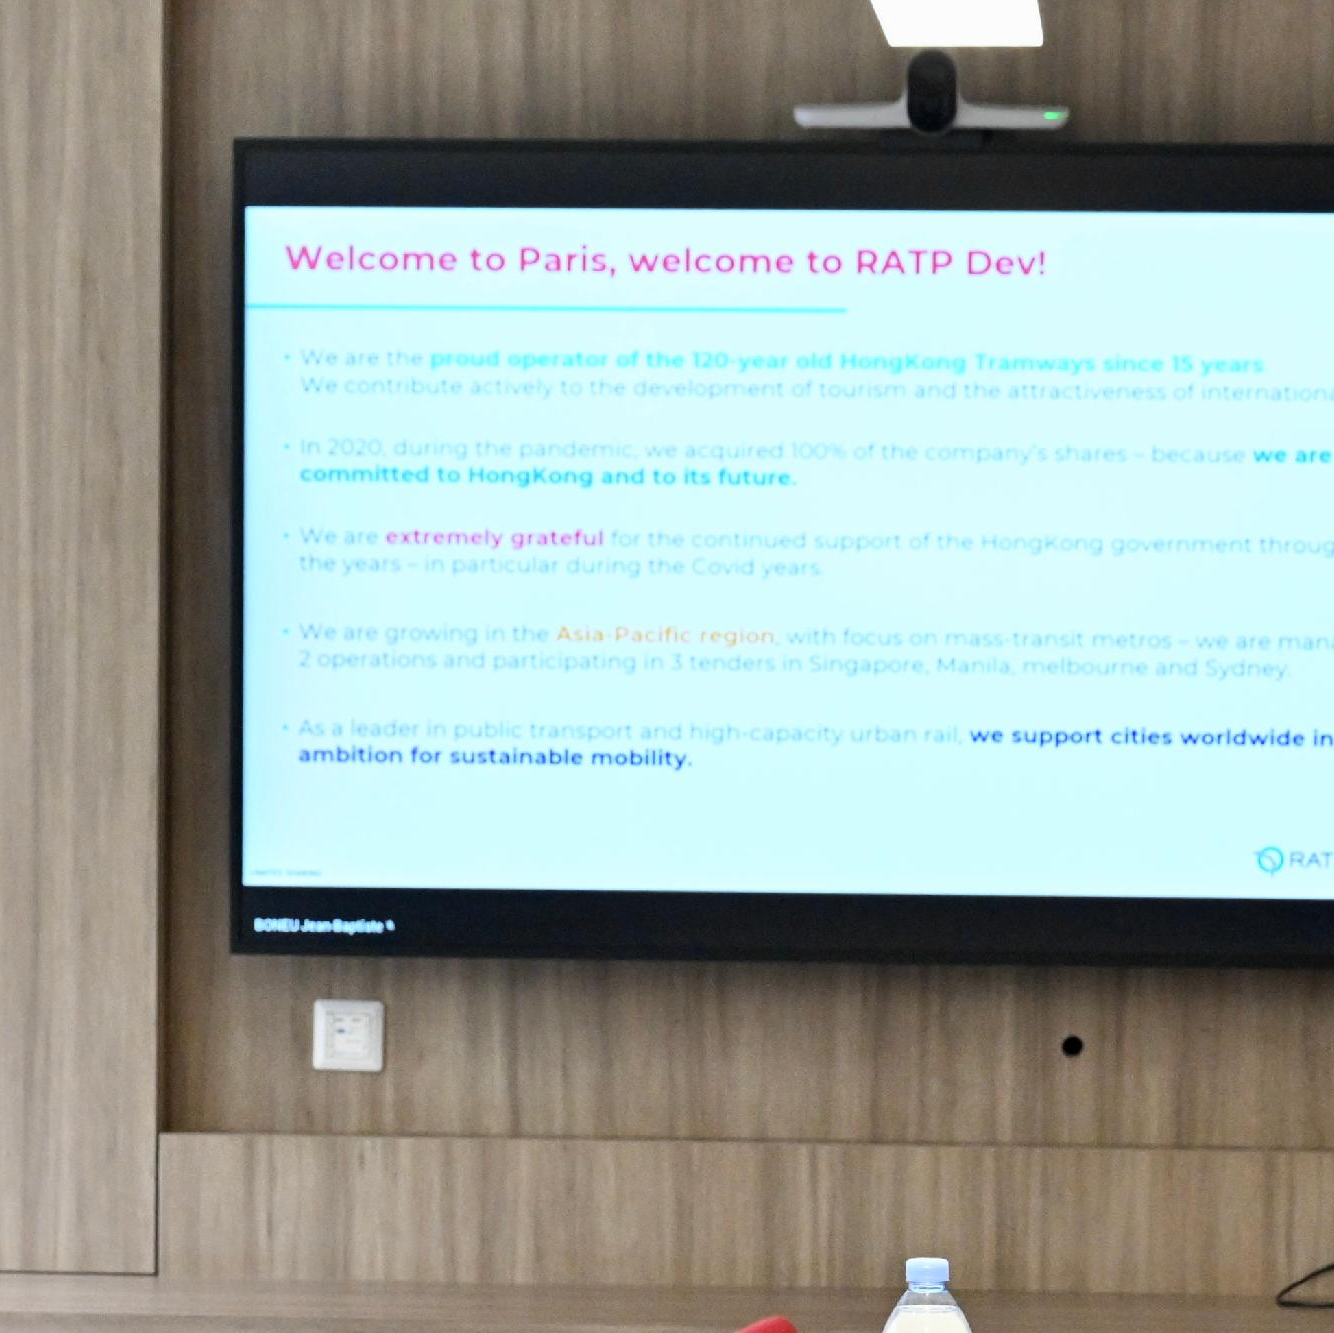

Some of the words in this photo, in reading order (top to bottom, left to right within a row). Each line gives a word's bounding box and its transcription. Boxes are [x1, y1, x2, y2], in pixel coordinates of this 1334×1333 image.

[285, 243, 457, 270] Welcome
[470, 246, 506, 271] to
[520, 245, 615, 275] Paris,
[629, 246, 793, 273] welcome
[807, 248, 842, 274] to
[857, 247, 953, 274] RATP
[967, 248, 1045, 275] Dev!
[300, 346, 339, 365] We
[344, 351, 380, 366] are
[386, 347, 423, 366] the
[429, 347, 501, 371] proud
[507, 350, 608, 372] operator
[615, 349, 640, 368] of
[645, 349, 685, 368] the
[692, 350, 789, 373] 120-year
[795, 350, 834, 370] old
[839, 351, 967, 374] HongKong
[975, 352, 1096, 375] Tramways
[1103, 353, 1165, 372] since
[1171, 353, 1195, 373] 15
[301, 374, 339, 394] We
[344, 374, 463, 394] contribute
[470, 375, 552, 400] actively
[559, 377, 584, 396] to
[589, 376, 626, 396] the
[633, 377, 784, 401] development
[791, 378, 813, 398] of
[819, 378, 906, 398] tourism
[914, 379, 957, 399] and
[963, 379, 1001, 399] the
[1008, 380, 1167, 400] attractiveness
[1173, 381, 1195, 401] of
[299, 436, 322, 455] In
[393, 437, 468, 461] during
[475, 437, 512, 457] the
[645, 443, 677, 458] we
[684, 439, 784, 463] acquired
[791, 440, 844, 460] 100%
[852, 441, 875, 460] of
[881, 441, 919, 460] the
[1053, 443, 1127, 462] shares
[1150, 443, 1245, 463] because
[1252, 448, 1288, 464] we
[1293, 449, 1332, 464] are
[299, 463, 430, 483] committed
[436, 466, 461, 483] to
[468, 465, 594, 488] HongKong
[601, 465, 646, 485] and
[652, 467, 676, 485] to
[683, 466, 711, 485] its
[717, 466, 796, 485] future.
[300, 525, 338, 544] We
[343, 529, 378, 544] are
[386, 526, 503, 549] extremely
[511, 527, 604, 550] grateful
[611, 528, 640, 547] for
[647, 528, 685, 547] the
[691, 529, 807, 548] continued
[814, 532, 901, 553] support
[909, 531, 930, 550] of
[936, 531, 974, 550] the
[981, 532, 1104, 555] HongKong
[1111, 535, 1251, 557] government
[299, 552, 336, 572] the
[342, 556, 402, 577] years
[424, 553, 445, 573] in
[451, 553, 558, 578] particular
[566, 554, 642, 579] during
[647, 555, 686, 575] the
[691, 556, 755, 576] Covid
[299, 621, 338, 640] We
[343, 625, 378, 640] are
[384, 622, 477, 645] growing
[484, 623, 505, 642] in
[512, 623, 549, 642] the
[556, 624, 690, 643] Asia-Pacific
[788, 626, 836, 645] with
[842, 627, 903, 646] focus
[909, 631, 938, 646] on
[943, 628, 1084, 647] mass-transit
[1090, 631, 1173, 648] metros
[1195, 634, 1228, 649] we
[1234, 635, 1271, 650] are
[298, 647, 311, 667] 2
[317, 648, 435, 672] operations
[443, 649, 486, 669] and
[491, 650, 637, 674] participating
[642, 651, 664, 671] in
[670, 651, 684, 671] 3
[688, 652, 776, 672] tenders
[781, 653, 803, 672] in
[1022, 656, 1149, 676] melbourne
[1155, 657, 1198, 677] and
[298, 719, 324, 737] As
[330, 723, 344, 738] a
[350, 720, 418, 738] leader
[425, 720, 447, 739] in
[453, 721, 521, 743] public
[529, 723, 632, 744] transport
[640, 722, 683, 740] and
[688, 723, 843, 745] high-capacity
[850, 724, 917, 742] urban
[970, 729, 1004, 743] we
[1012, 727, 1102, 748] support
[1111, 726, 1173, 745] cities
[1180, 727, 1304, 745] worldwide
[1313, 728, 1334, 746] in
[298, 745, 403, 763] ambition
[410, 745, 441, 763] for
[450, 746, 583, 764] sustainable
[591, 748, 692, 769] mobility.
